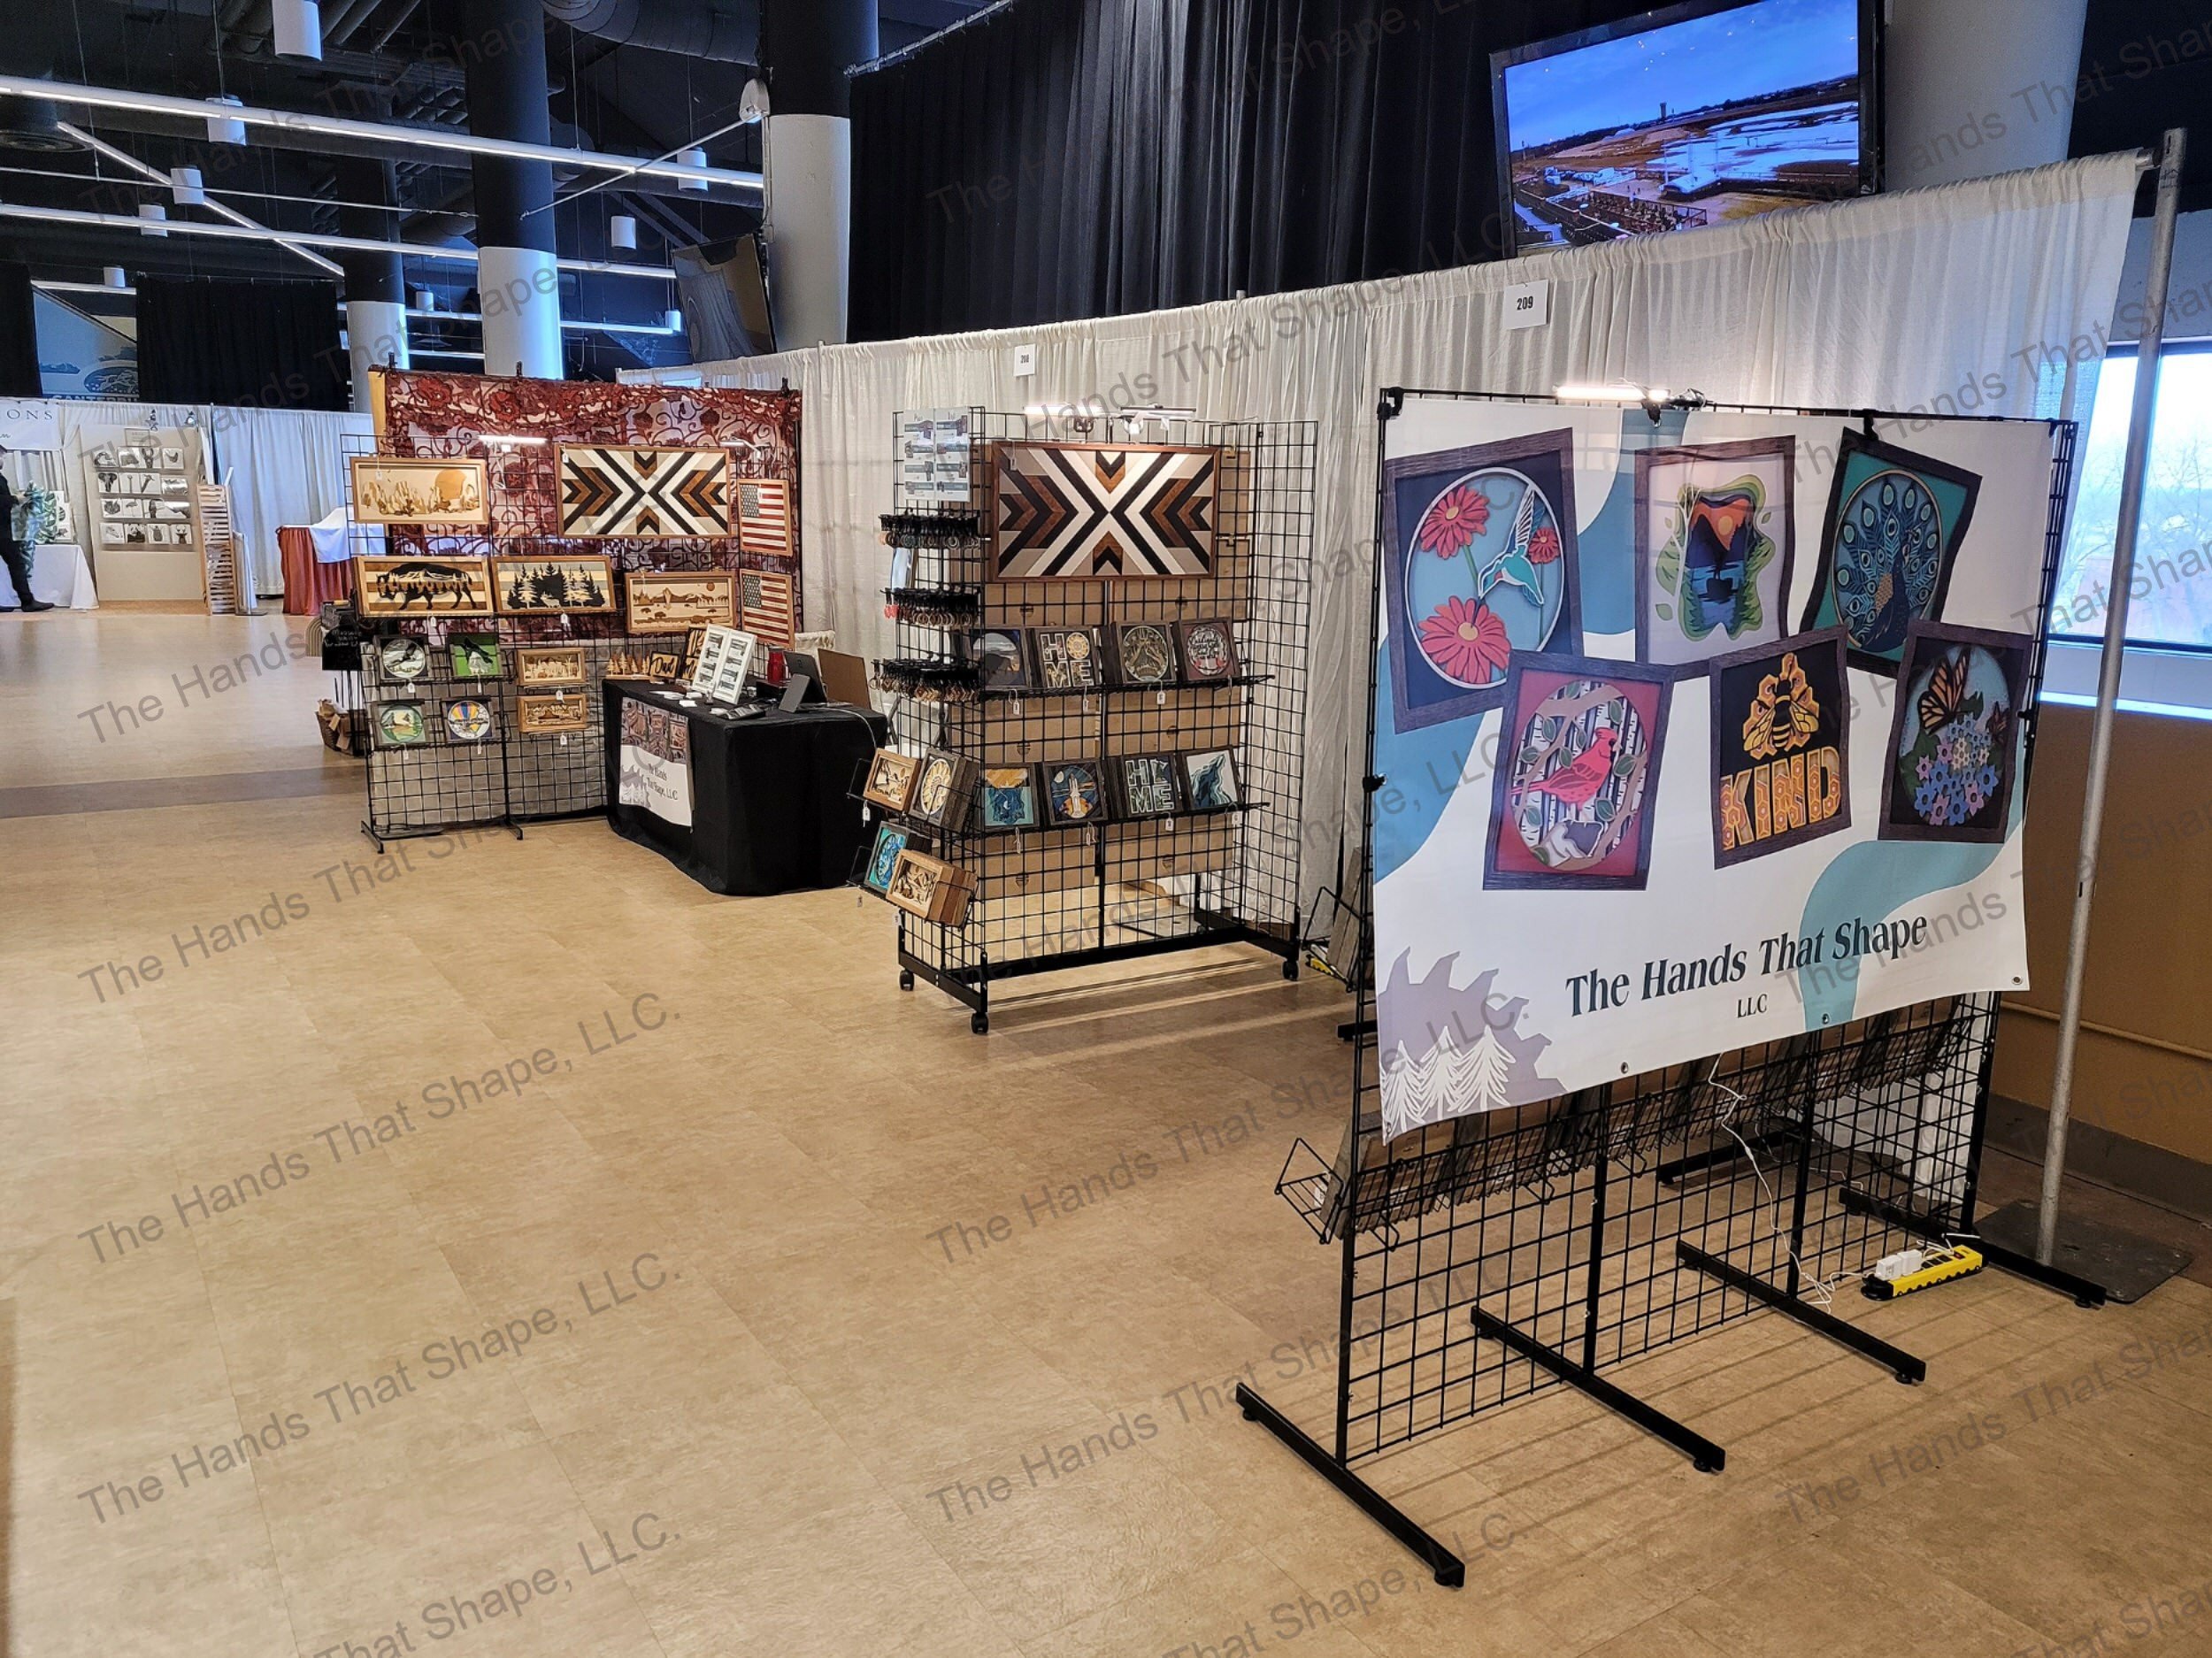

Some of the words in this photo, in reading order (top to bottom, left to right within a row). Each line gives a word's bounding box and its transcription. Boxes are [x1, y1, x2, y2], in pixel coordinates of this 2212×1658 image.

[1516, 296, 1533, 311] 209
[1719, 746, 1841, 851] KIND
[1565, 968, 1630, 1017] The
[1641, 943, 1747, 1001] Hands
[1759, 926, 1824, 976] That
[1832, 915, 1927, 961] Shape
[1736, 993, 1768, 1018] LLC
